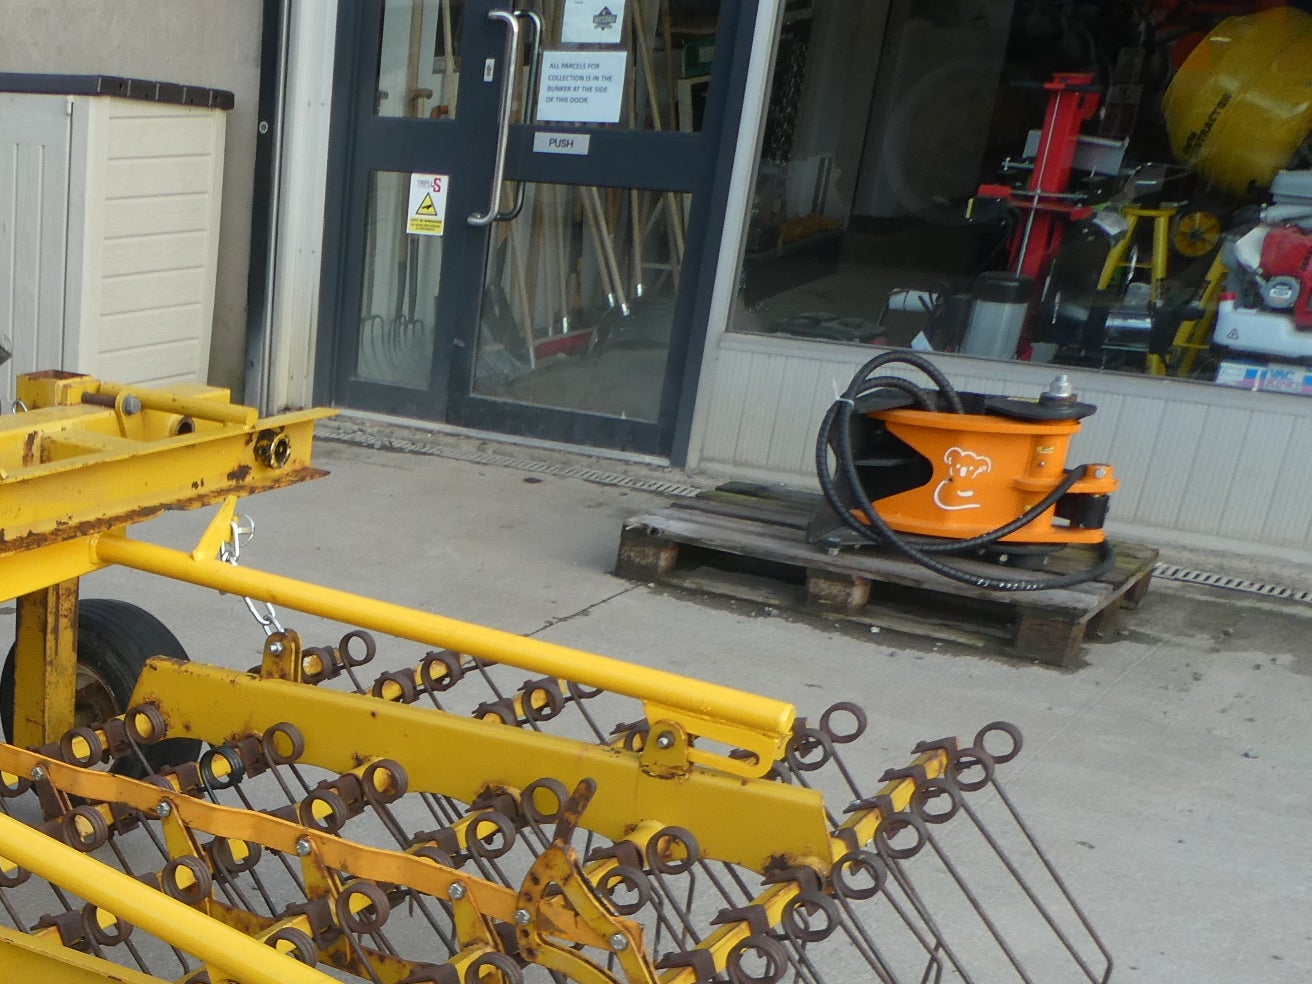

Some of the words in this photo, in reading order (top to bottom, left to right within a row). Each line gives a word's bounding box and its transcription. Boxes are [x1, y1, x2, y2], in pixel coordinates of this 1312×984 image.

[549, 62, 560, 70] ALL
[548, 74, 584, 82] COLLECTION
[545, 96, 555, 104] OF
[548, 137, 574, 148] PUSH
